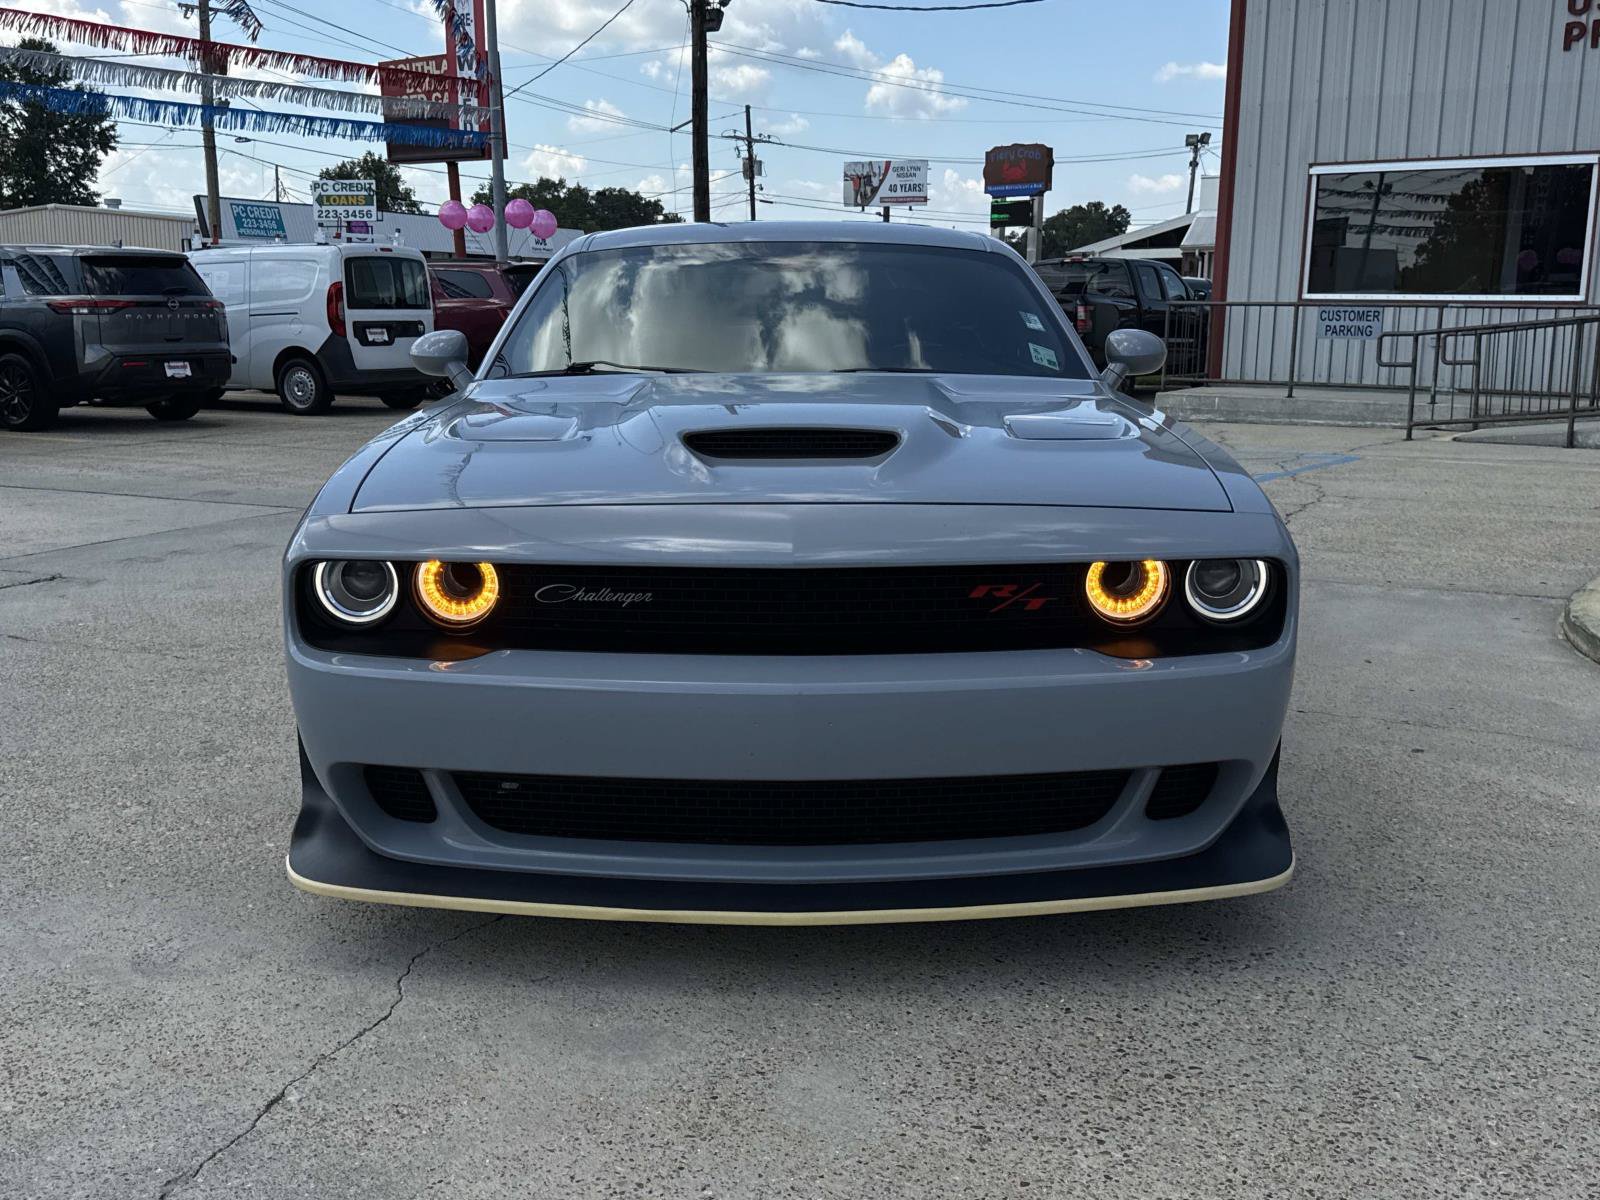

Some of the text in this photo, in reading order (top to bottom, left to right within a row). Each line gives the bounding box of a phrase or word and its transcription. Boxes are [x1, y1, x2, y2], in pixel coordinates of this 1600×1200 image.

[388, 59, 448, 75] UTHLA
[313, 182, 374, 193] PC CREDIT
[888, 183, 898, 193] 40
[323, 195, 366, 206] LOANS
[232, 205, 279, 220] PC CREDIT
[317, 209, 373, 219] 223-3456
[242, 218, 278, 230] 223-3456
[1320, 310, 1381, 322] CUSTOMER
[1324, 324, 1373, 337] PARKING
[534, 583, 653, 608] Challenger
[967, 582, 1059, 613] R/T
